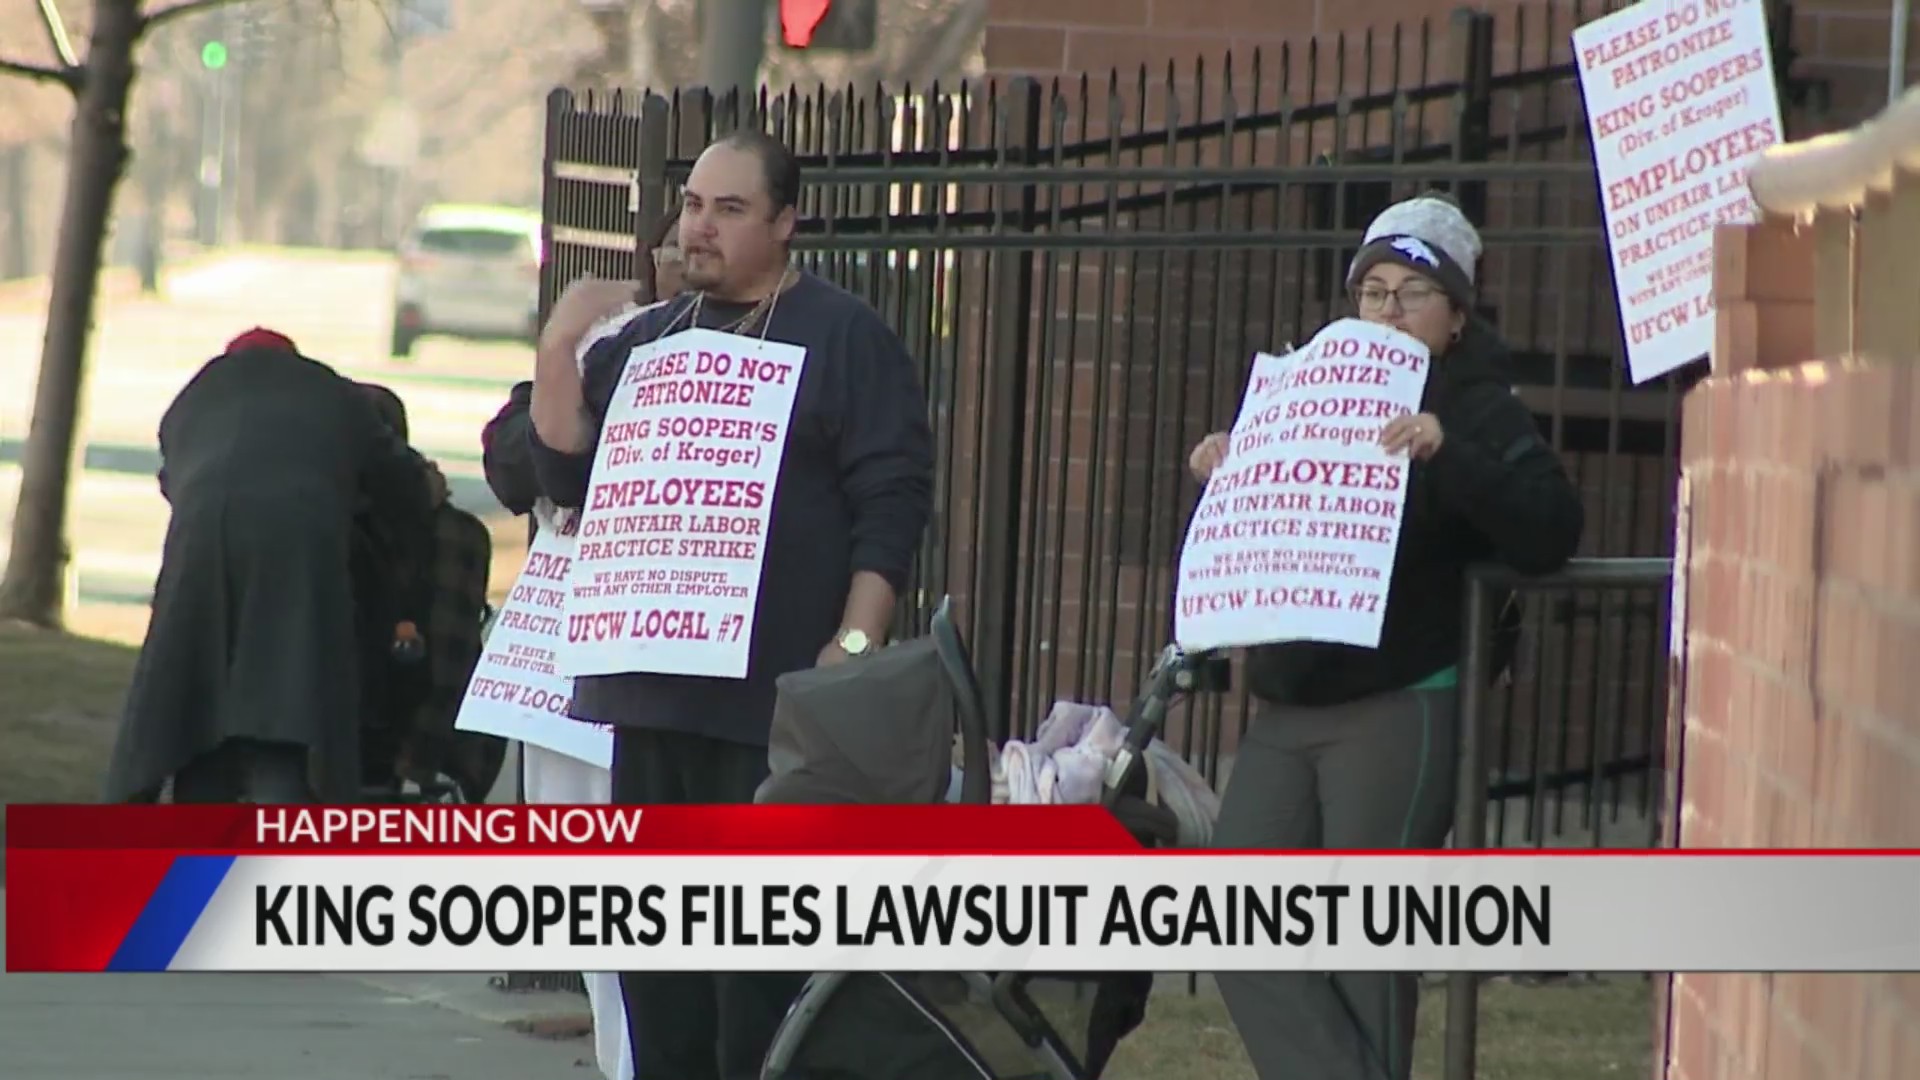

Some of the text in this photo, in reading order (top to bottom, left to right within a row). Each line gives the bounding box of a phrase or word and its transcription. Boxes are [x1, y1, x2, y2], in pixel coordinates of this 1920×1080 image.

[623, 351, 792, 385] PLEASE DO NOT
[1321, 338, 1360, 359] DO
[1366, 341, 1424, 373] NOT
[1254, 364, 1391, 395] PRONIZE
[633, 381, 755, 408] PATRONIZE
[605, 417, 778, 444] KING SOOPER'S
[1279, 425, 1299, 441] of
[1302, 423, 1383, 446] Kroger)
[606, 443, 761, 470] (Div. of Kroger)
[1208, 459, 1401, 498] EMPLOYEES
[590, 478, 765, 512] EMPLOYEES
[1233, 493, 1312, 513] UNFAIR
[1318, 495, 1397, 519] LABOR
[583, 519, 610, 538] ON
[613, 514, 682, 535] UNFAIR
[689, 515, 761, 536] LABOR
[1191, 519, 1392, 549] PRACTICE STRIKE
[578, 538, 756, 561] PRACTICE STRIKE
[1272, 549, 1294, 560] NO
[594, 569, 728, 584] WE HAVE NO DISPUTE
[1253, 562, 1299, 574] OTHER
[1303, 564, 1381, 580] EMPLOYER
[513, 584, 537, 604] ON
[573, 583, 749, 599] WITH ANY OTHER EMPLOYER
[1182, 586, 1380, 618] UFCW LOCAL #7
[567, 609, 745, 643] UFCW LOCAL #7
[471, 677, 574, 718] UFCW LOCA
